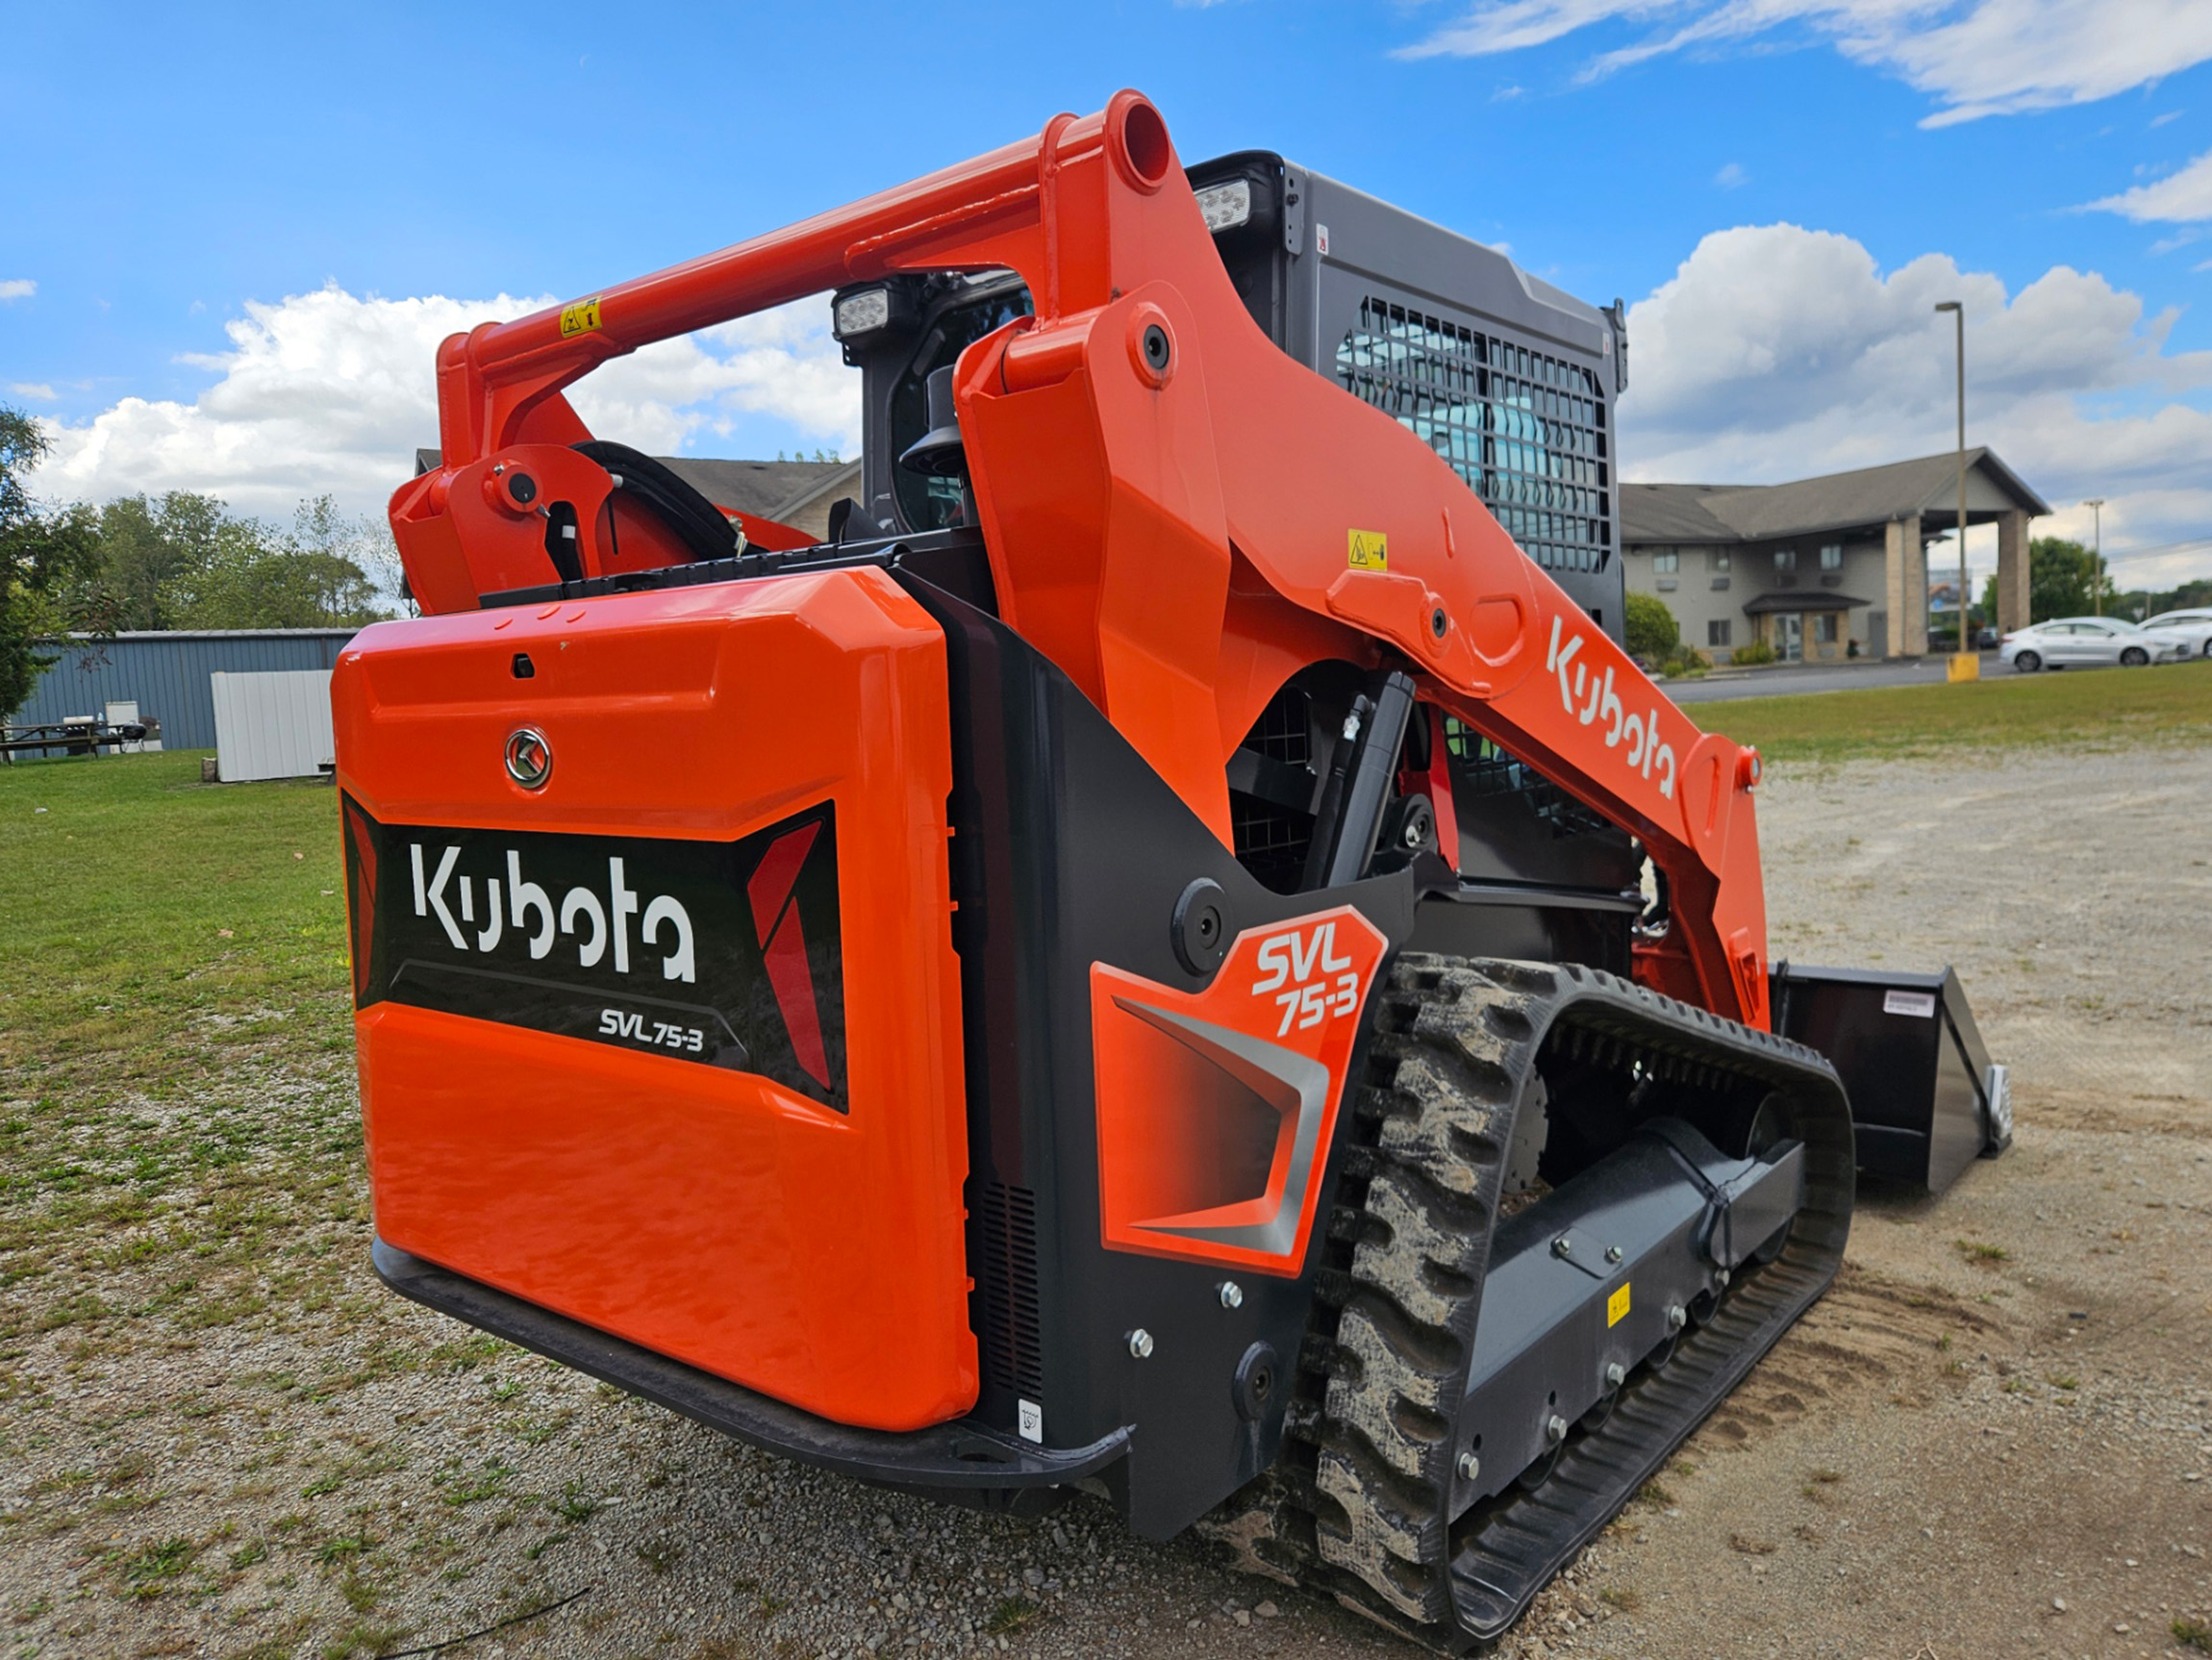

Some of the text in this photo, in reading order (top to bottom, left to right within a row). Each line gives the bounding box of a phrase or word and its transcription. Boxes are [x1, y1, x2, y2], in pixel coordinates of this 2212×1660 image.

[1546, 615, 1675, 799] Kubota
[410, 843, 695, 983] Kubota
[1251, 921, 1351, 995] SVL
[1275, 973, 1358, 1038] 75-3
